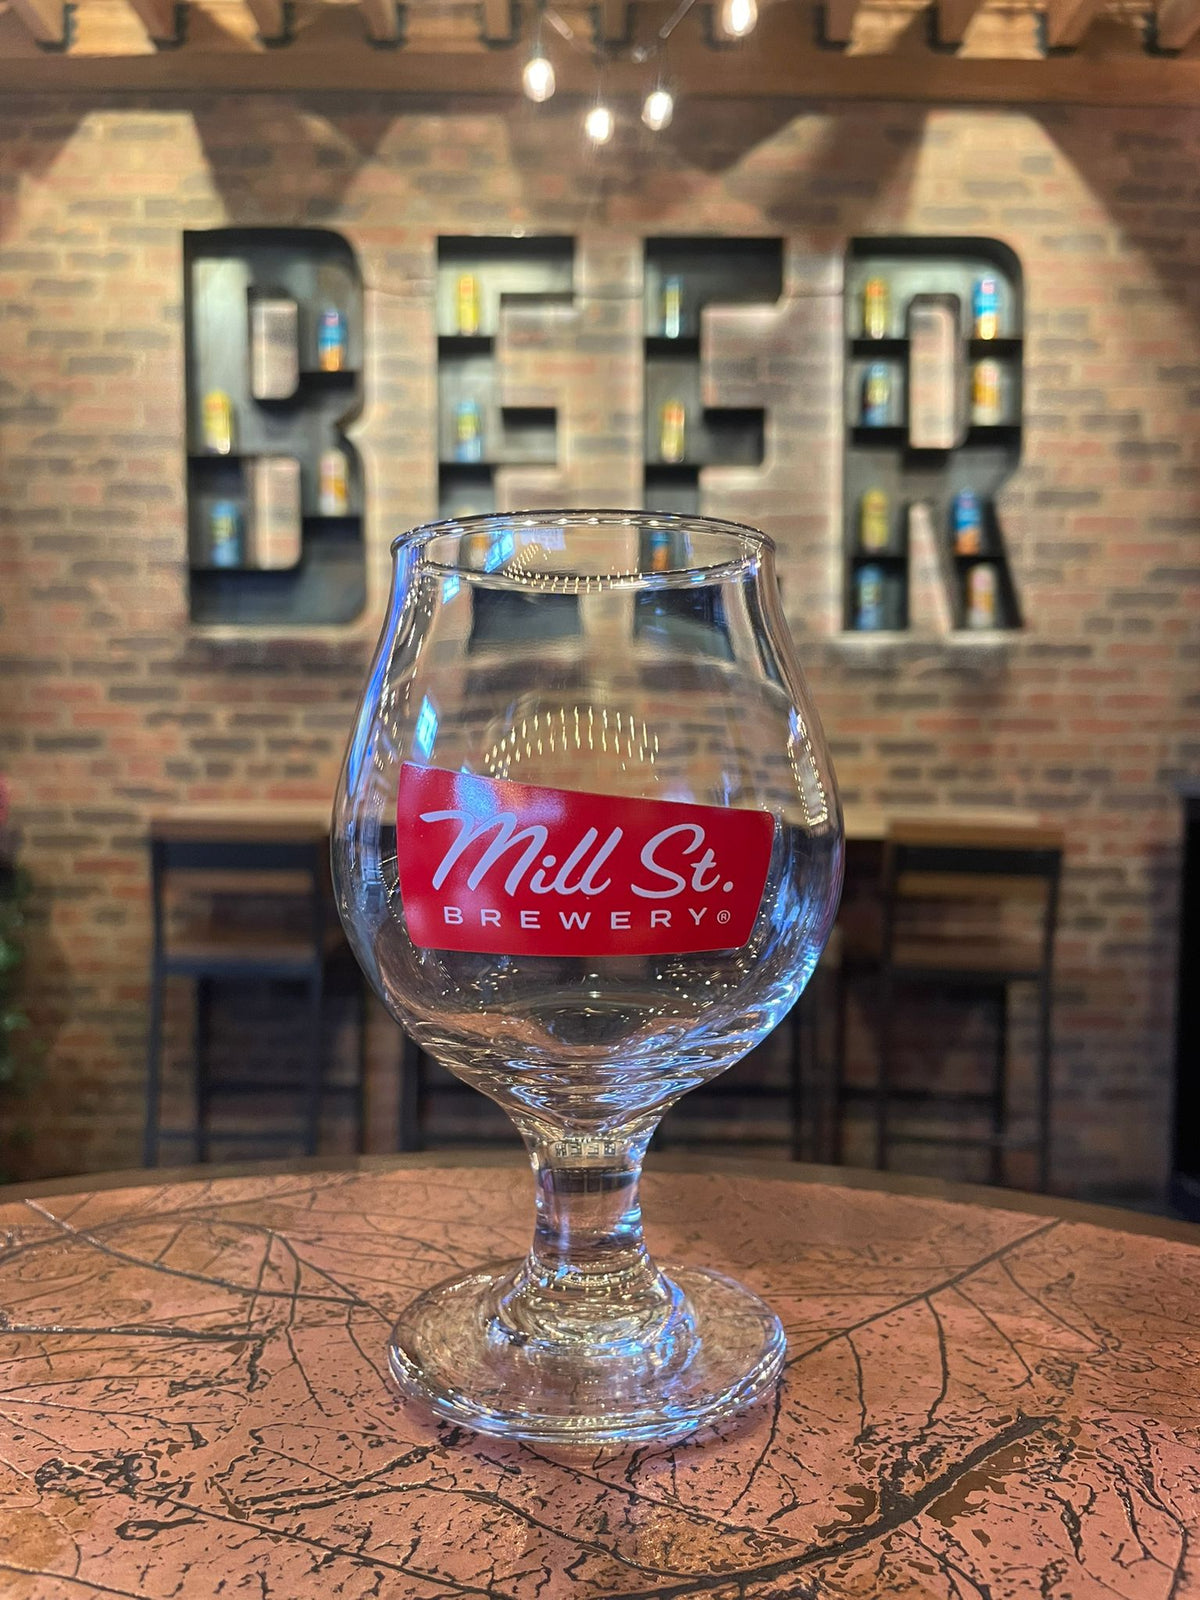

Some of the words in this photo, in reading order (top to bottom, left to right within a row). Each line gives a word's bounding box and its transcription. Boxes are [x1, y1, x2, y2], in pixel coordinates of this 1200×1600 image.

[183, 228, 1024, 631] BEER
[419, 809, 624, 897] Mill
[630, 822, 735, 899] St.
